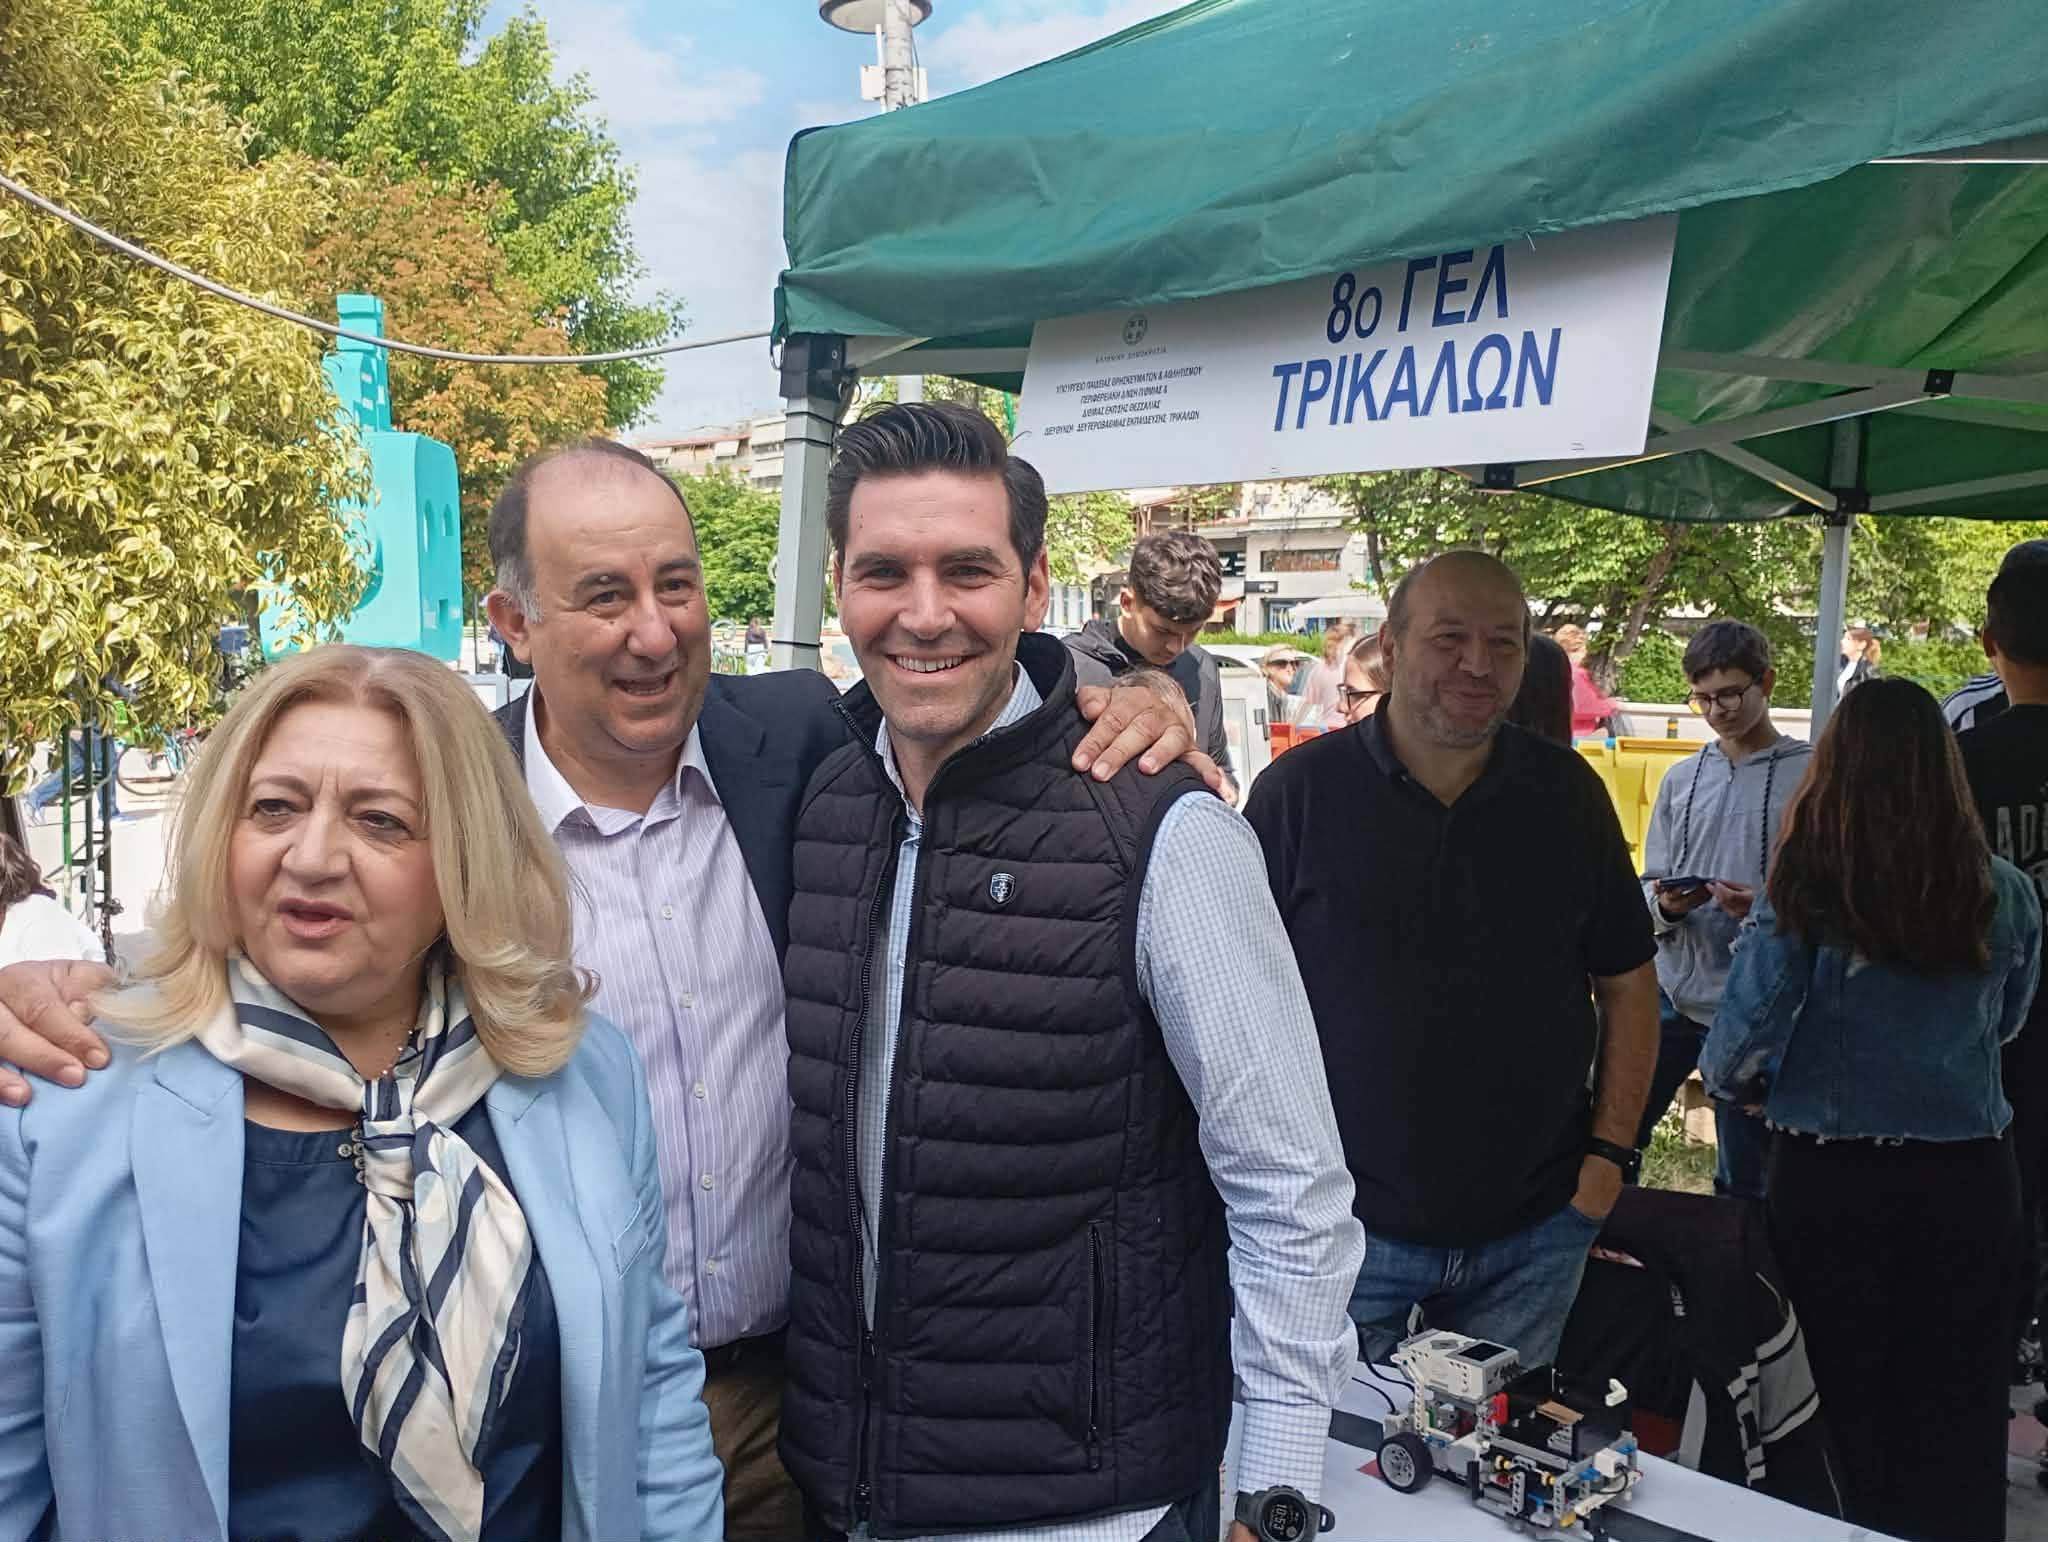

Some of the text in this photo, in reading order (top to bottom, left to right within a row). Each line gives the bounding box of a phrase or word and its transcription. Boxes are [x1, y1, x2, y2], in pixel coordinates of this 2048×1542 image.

[1398, 245, 1508, 333] ΓΕΛ
[1055, 381, 1086, 394] ΥΠΟΥΡΓΕΙΟ
[1157, 370, 1163, 381] &
[1272, 327, 1562, 432] ΤΡΙΚΑΛΩΝ
[1168, 410, 1200, 423] ΤΡΙΚΑΛΩΝ
